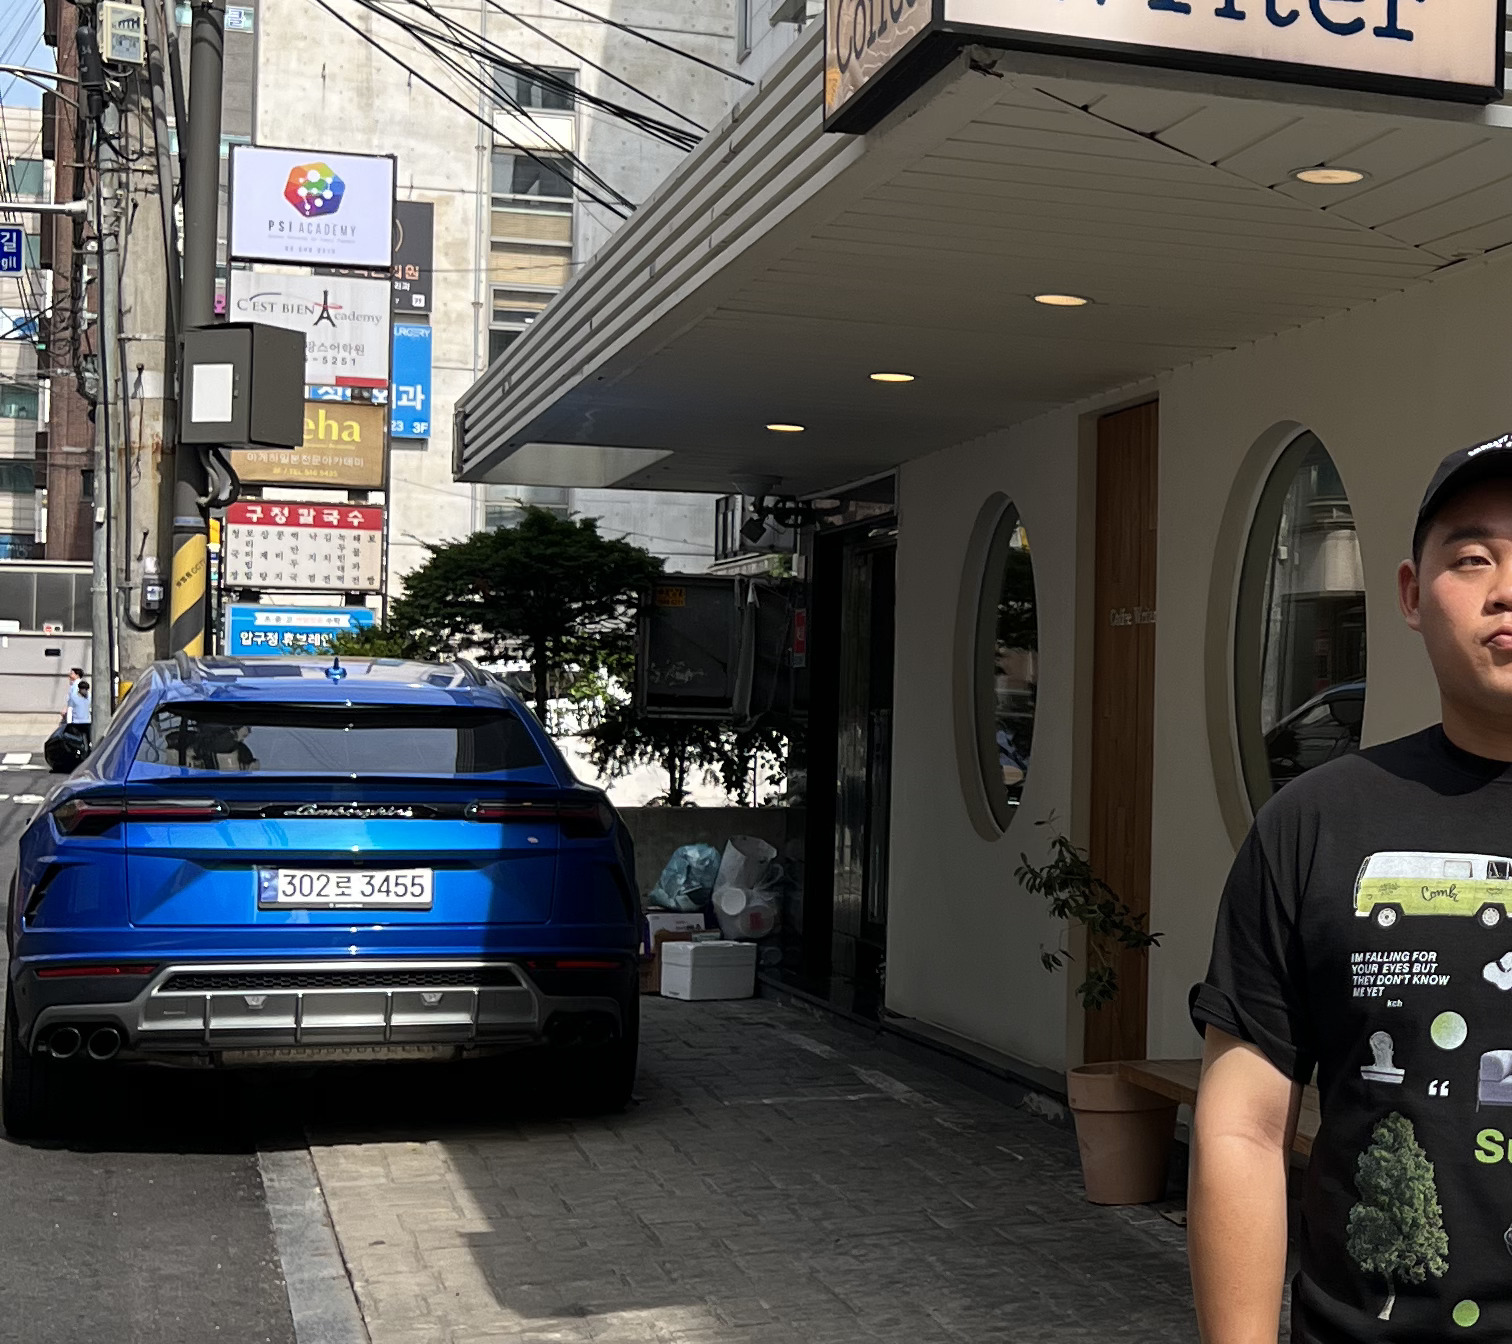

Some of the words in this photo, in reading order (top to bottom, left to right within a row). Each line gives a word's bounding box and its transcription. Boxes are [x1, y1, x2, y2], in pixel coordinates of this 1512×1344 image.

[268, 219, 293, 233] PSI
[298, 221, 357, 237] ACADEMY
[0, 231, 17, 253] 길
[282, 302, 315, 316] BIEN
[412, 422, 429, 434] 3F
[240, 631, 279, 647] 압구정
[282, 874, 352, 897] 302로
[360, 874, 425, 898] 3455
[1365, 952, 1410, 962] FALLING
[1412, 951, 1437, 962] FOR
[1351, 964, 1378, 974] YOUR
[1382, 963, 1410, 973] EYES
[1412, 963, 1438, 973] BUT
[1353, 976, 1375, 986] THEY
[1376, 975, 1411, 985] DON'T
[1412, 975, 1450, 985] KNOW
[1366, 987, 1385, 997] YET
